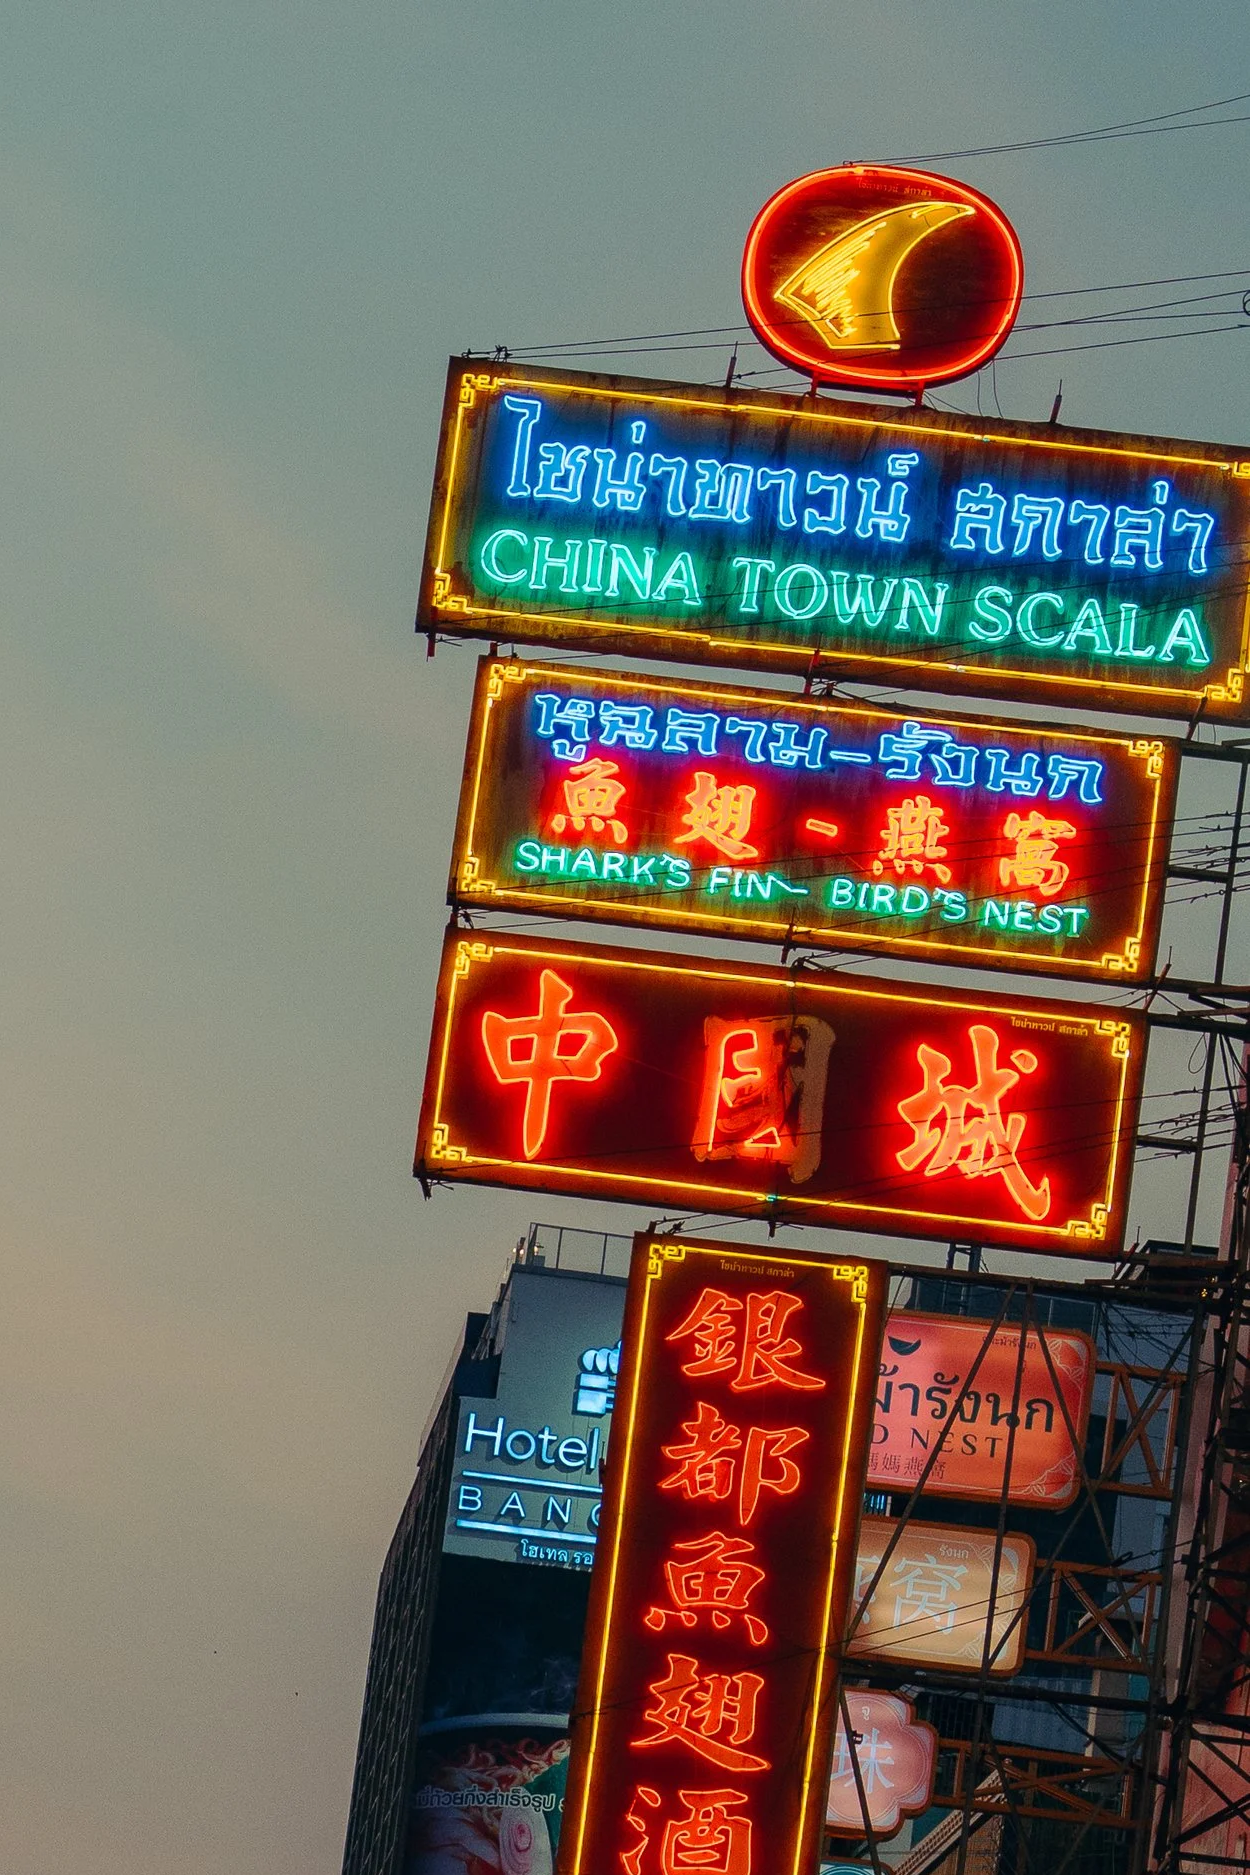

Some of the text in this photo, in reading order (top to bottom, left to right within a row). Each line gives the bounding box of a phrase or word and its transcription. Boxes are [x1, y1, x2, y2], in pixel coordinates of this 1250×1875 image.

[503, 394, 1216, 576] ไชน่าทาวน์ สกาล่า
[480, 527, 1212, 667] CHINA TOWN SCALA
[515, 842, 1090, 938] SHARK'S BIRD'S NEST
[464, 1412, 600, 1470] Hotel
[910, 1427, 1004, 1458] NEST
[520, 1538, 568, 1564] โฮเทล
[830, 1725, 895, 1795] 珠
